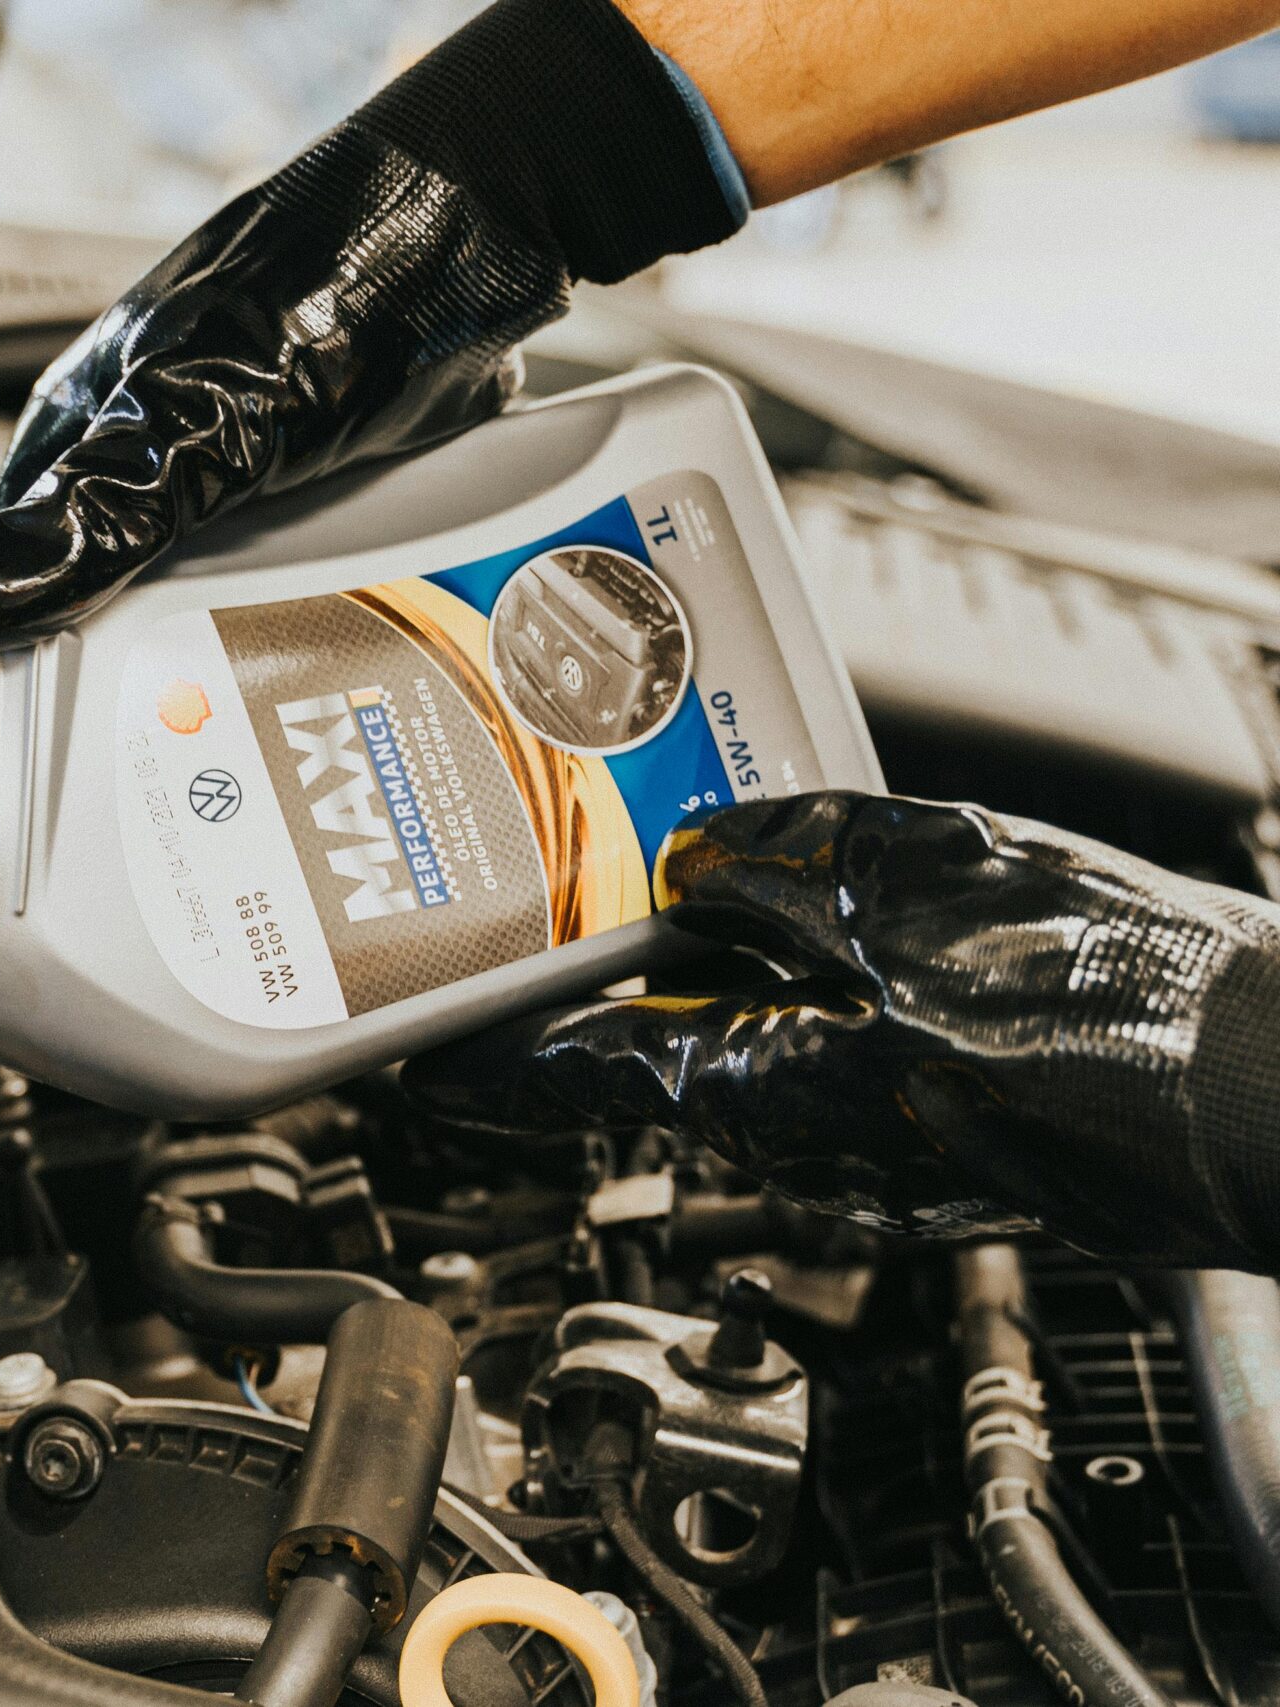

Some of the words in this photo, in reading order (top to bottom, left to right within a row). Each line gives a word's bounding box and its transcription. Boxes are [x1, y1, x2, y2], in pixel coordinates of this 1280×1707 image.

[646, 504, 678, 546] 1L
[410, 715, 443, 781] MOTOR
[413, 677, 467, 801] VOLKSWAGEN
[710, 690, 761, 787] 5W-40
[275, 692, 418, 923] MAXI
[361, 708, 446, 906] PERFORMANCE
[434, 785, 453, 810] DE
[444, 813, 471, 862] ÓLEO
[459, 804, 498, 891] ORIGINAL
[235, 896, 254, 920] 88
[254, 891, 272, 914] 99
[246, 926, 269, 962] 508
[264, 921, 287, 956] 509
[259, 970, 280, 1003] VW
[277, 964, 298, 997] VW
